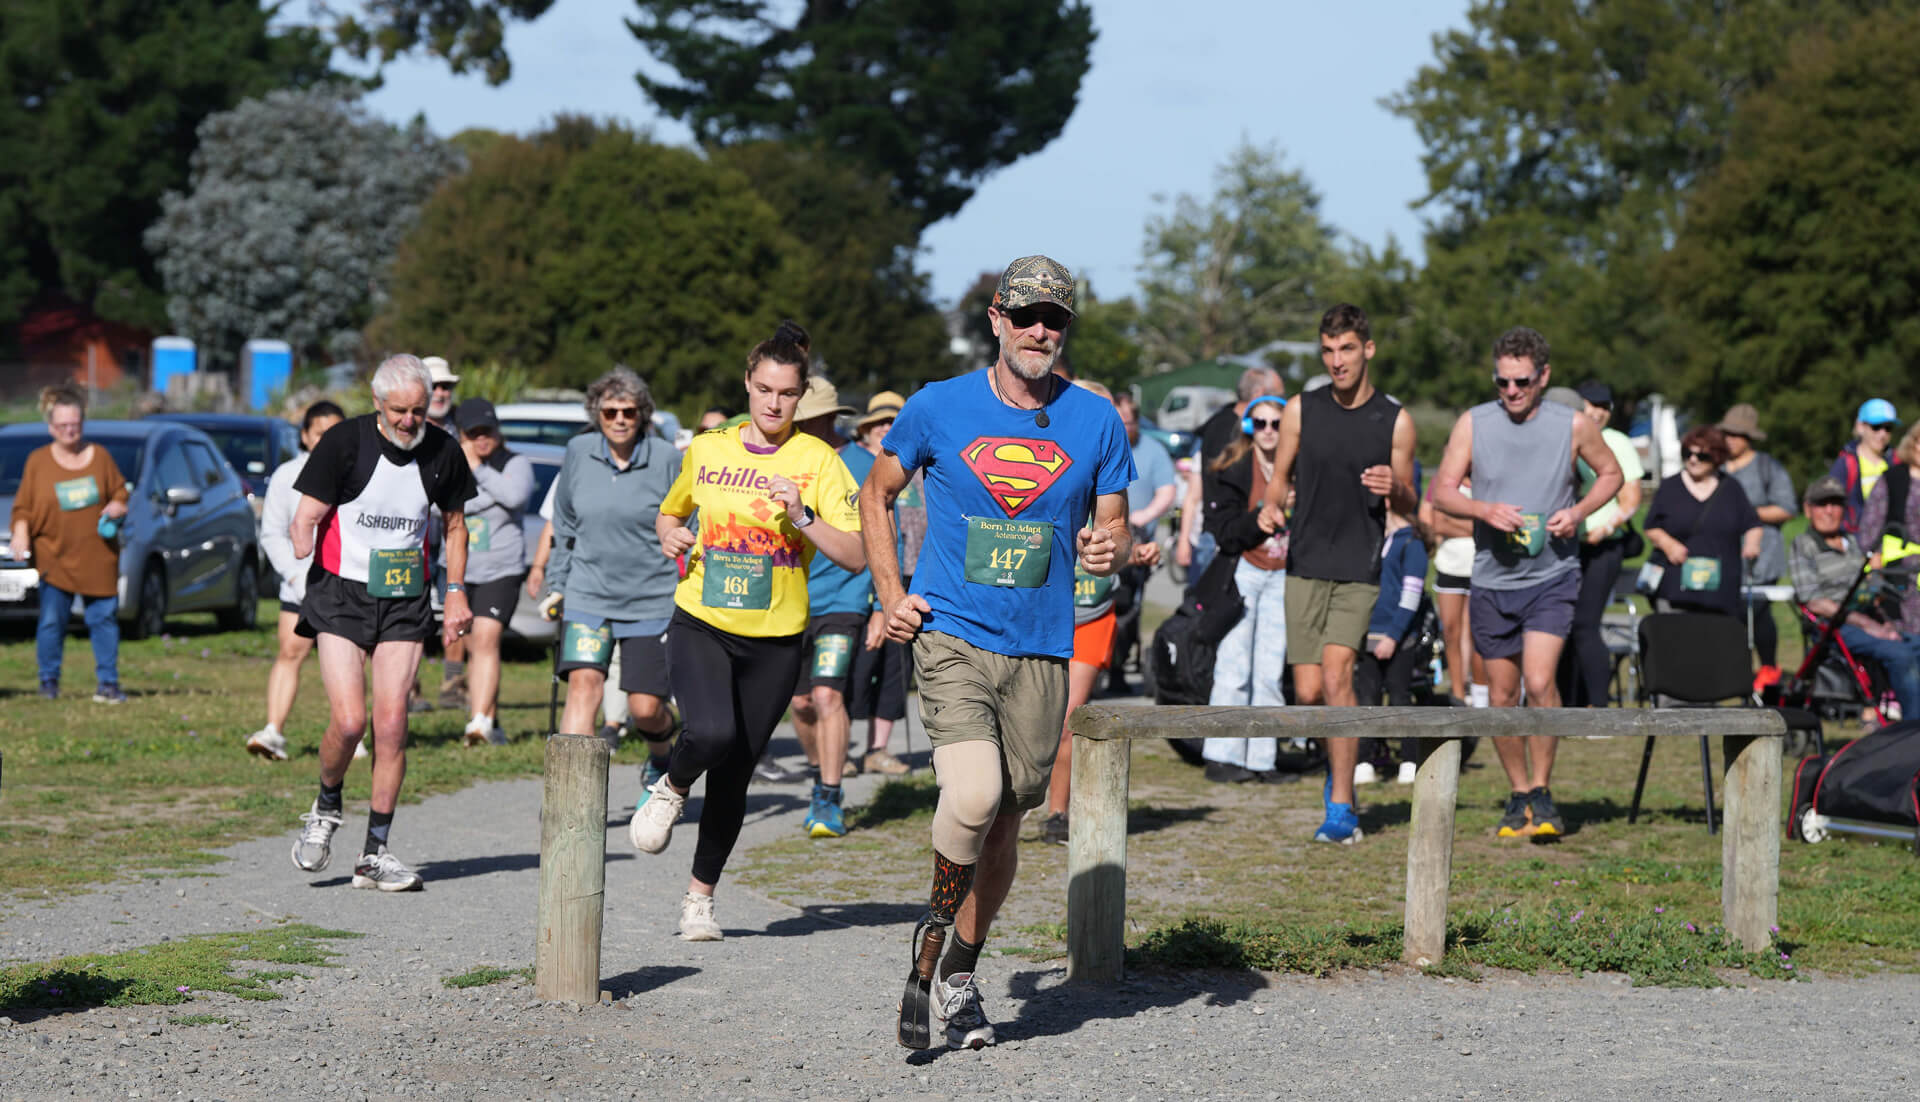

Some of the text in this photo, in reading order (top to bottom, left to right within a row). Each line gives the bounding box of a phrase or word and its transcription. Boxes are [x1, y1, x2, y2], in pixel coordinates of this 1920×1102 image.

[697, 465, 768, 490] Achille
[719, 487, 768, 497] INTERNATION
[356, 512, 425, 532] ASHBURTO
[980, 521, 1042, 534] Born To Adapt
[994, 532, 1027, 540] Aotearoa
[713, 553, 731, 562] Born
[989, 547, 1027, 570] 147
[384, 567, 411, 586] 134
[723, 575, 749, 595] 161
